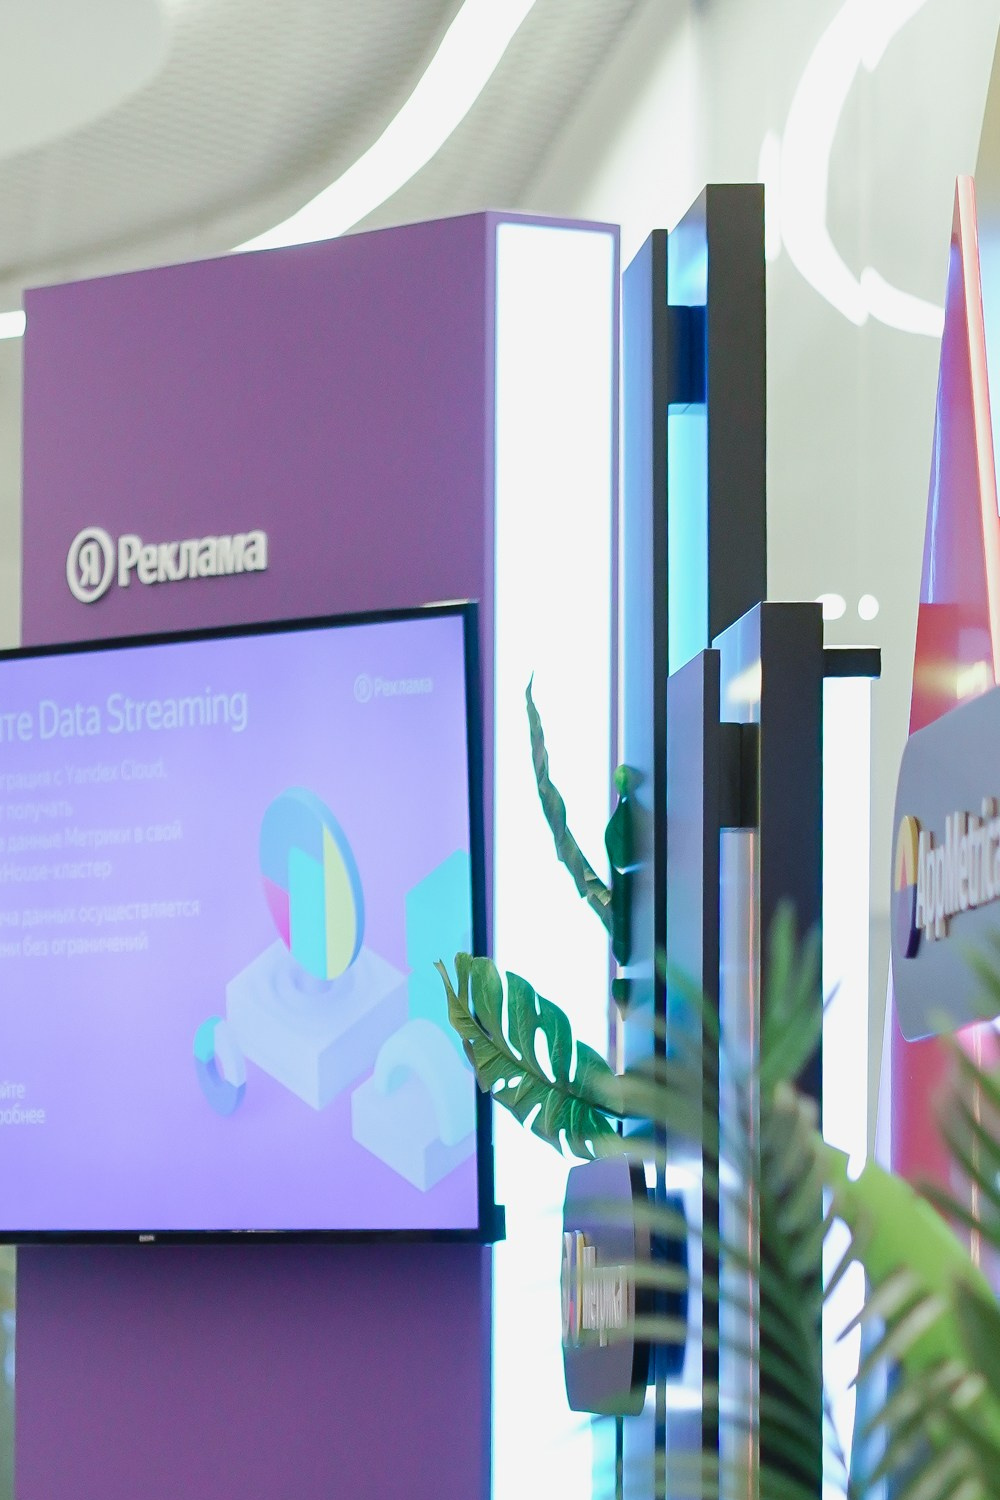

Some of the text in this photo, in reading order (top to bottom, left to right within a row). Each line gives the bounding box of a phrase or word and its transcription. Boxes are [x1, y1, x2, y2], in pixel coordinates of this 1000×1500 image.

[118, 528, 268, 587] Реклама
[374, 677, 433, 697] Реклама
[39, 698, 101, 740] Data
[107, 686, 248, 733] Streaming
[64, 760, 119, 785] Yandex
[79, 899, 200, 927] осуществляется
[51, 931, 150, 960] ограничений
